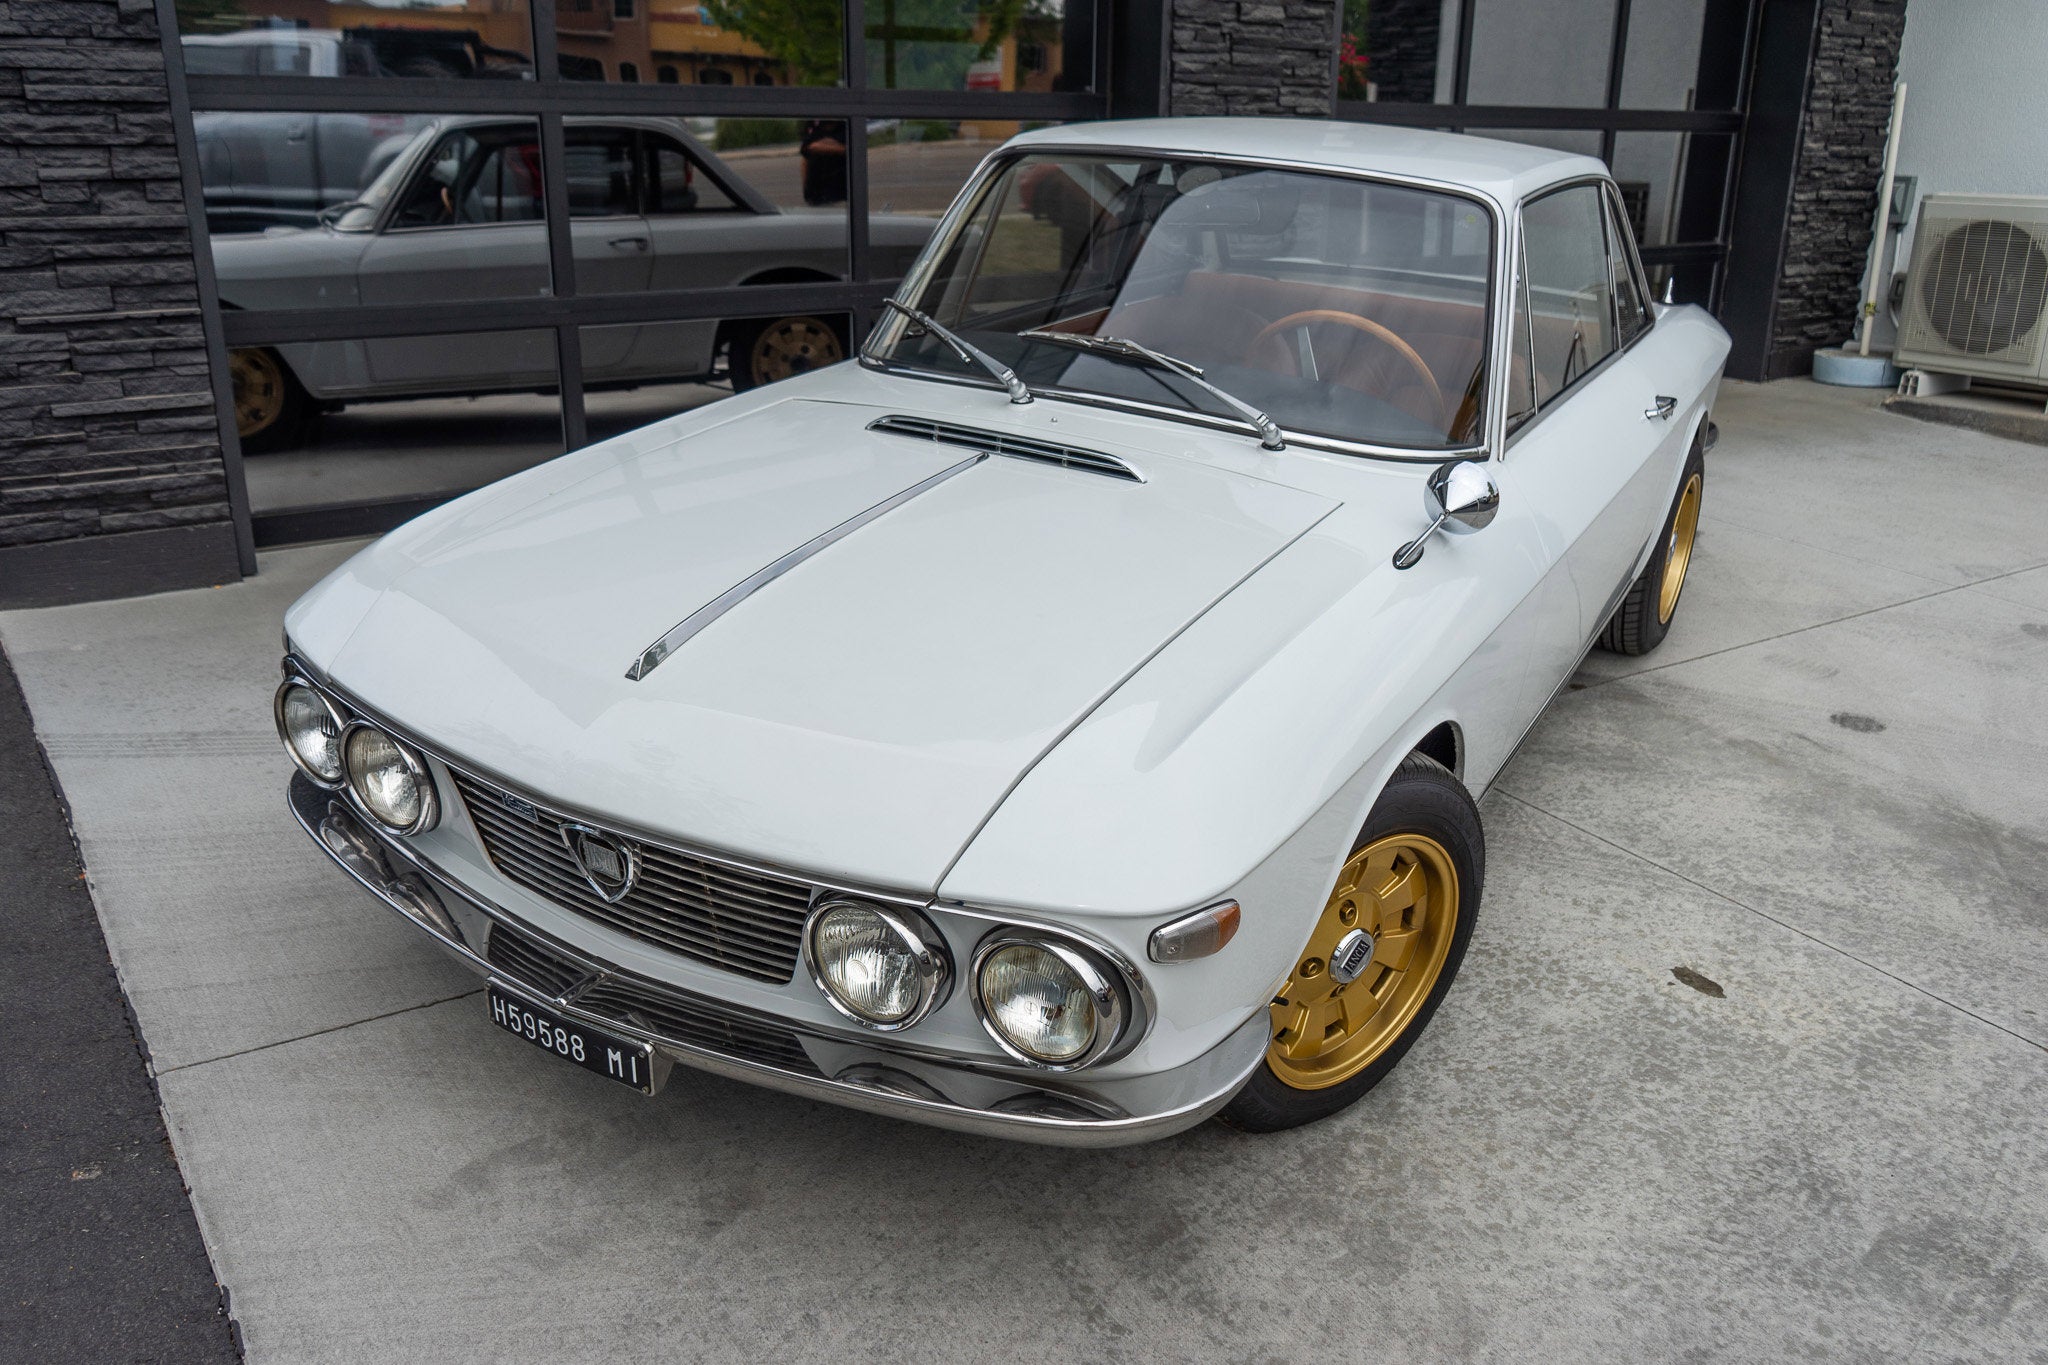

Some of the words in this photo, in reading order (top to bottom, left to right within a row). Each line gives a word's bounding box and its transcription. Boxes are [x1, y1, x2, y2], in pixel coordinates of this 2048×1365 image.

[1344, 941, 1369, 972] LANCIA
[493, 995, 586, 1062] H59588
[607, 1047, 637, 1084] MI
